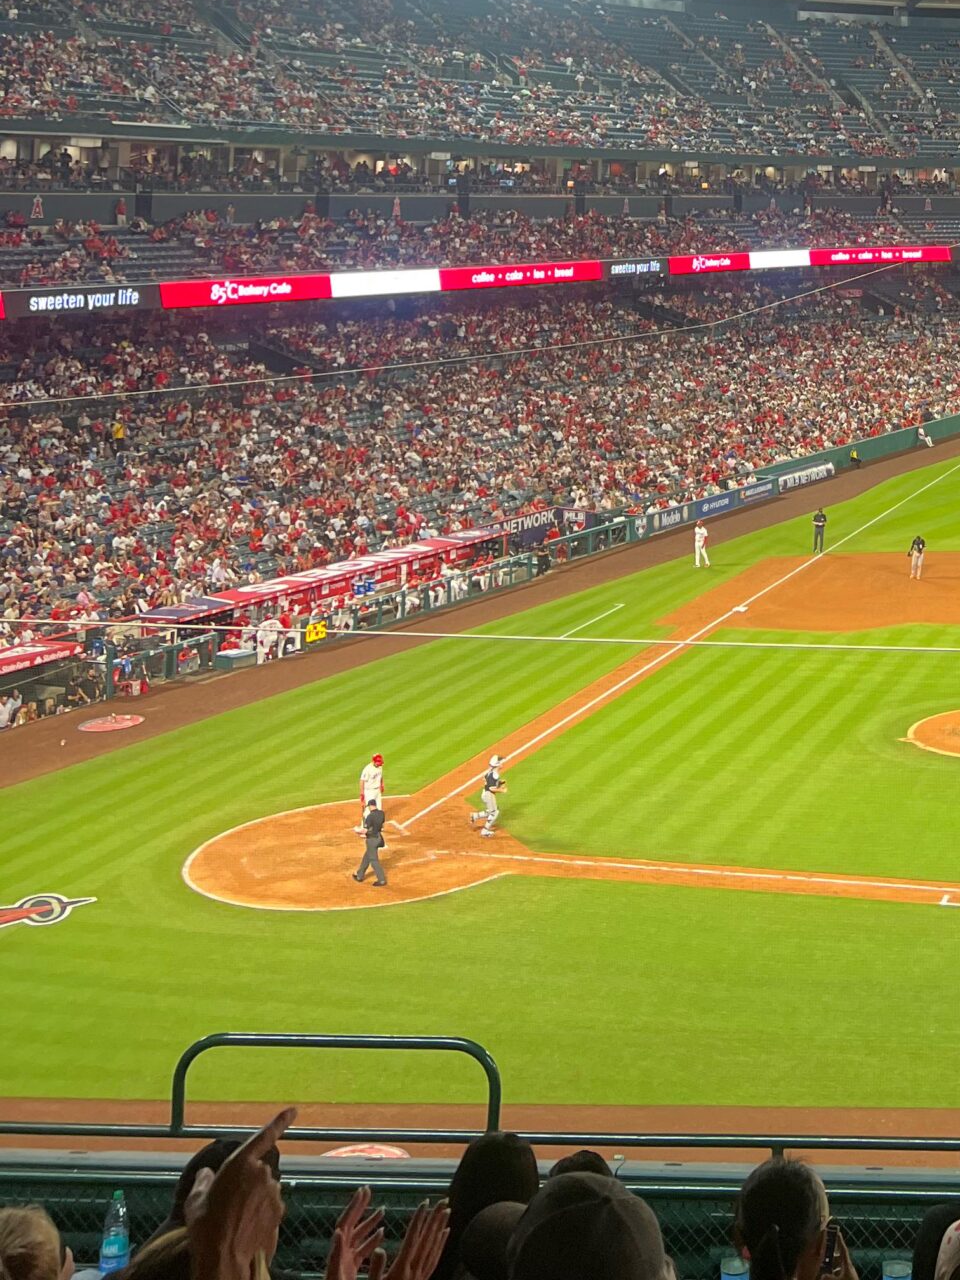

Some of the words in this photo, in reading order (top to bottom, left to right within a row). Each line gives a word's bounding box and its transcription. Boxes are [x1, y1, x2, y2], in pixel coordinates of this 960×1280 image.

[611, 262, 635, 275] sweeten
[636, 262, 649, 274] your
[650, 261, 660, 272] life
[29, 293, 84, 311] sweeten
[87, 293, 115, 310] your
[118, 288, 139, 305] life
[800, 466, 827, 484] NETWORK
[710, 498, 729, 509] HYUNDAI
[503, 509, 555, 533] NETWORK
[564, 511, 584, 520] MLB
[661, 510, 681, 528] Modelo
